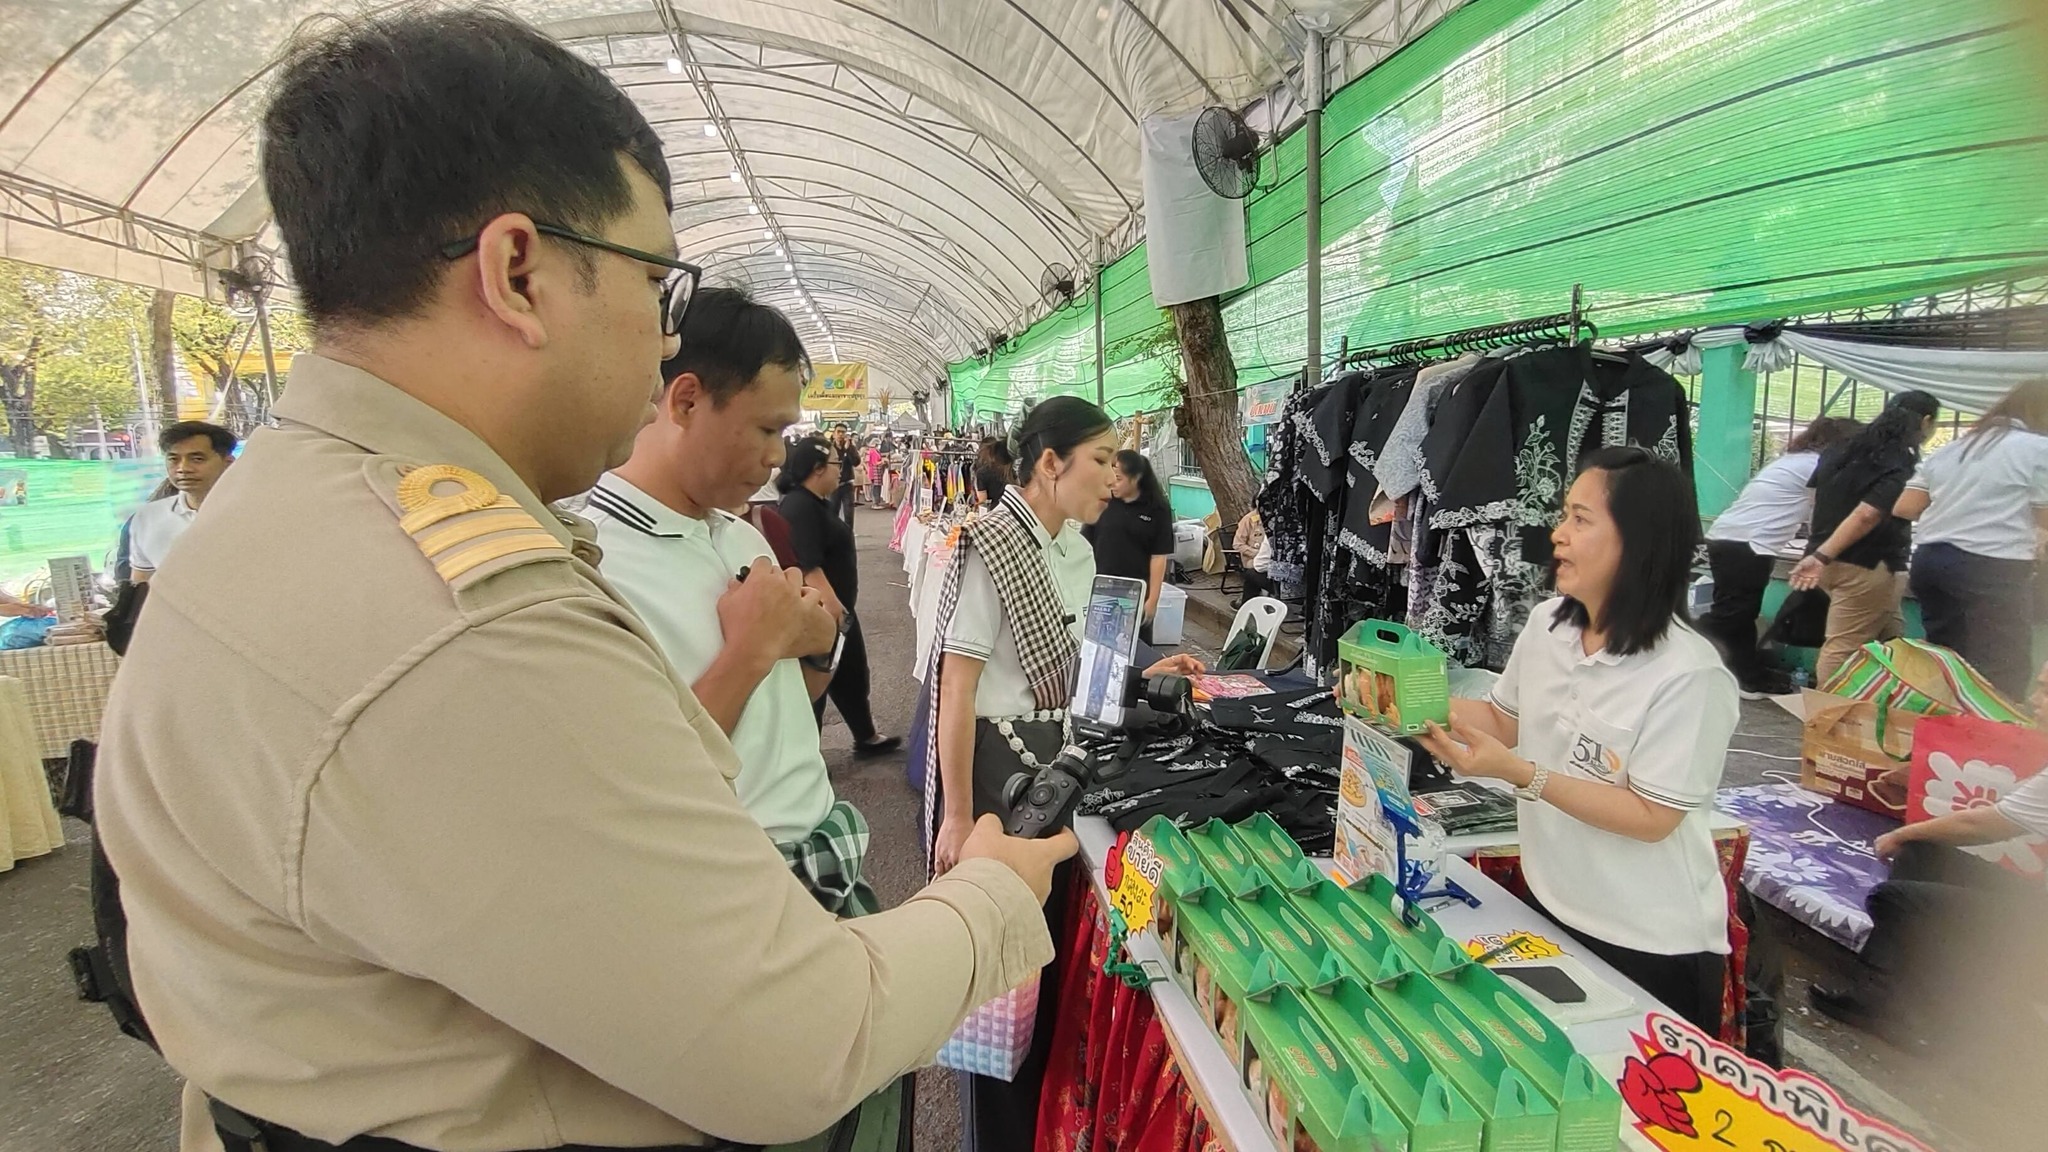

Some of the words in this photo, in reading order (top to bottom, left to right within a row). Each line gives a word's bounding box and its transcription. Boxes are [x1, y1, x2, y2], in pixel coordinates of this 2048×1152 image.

[824, 378, 864, 389] ZONE
[1131, 831, 1154, 860] สินค้า
[1127, 845, 1162, 885] ขายดี
[1711, 1108, 1738, 1149] 2
